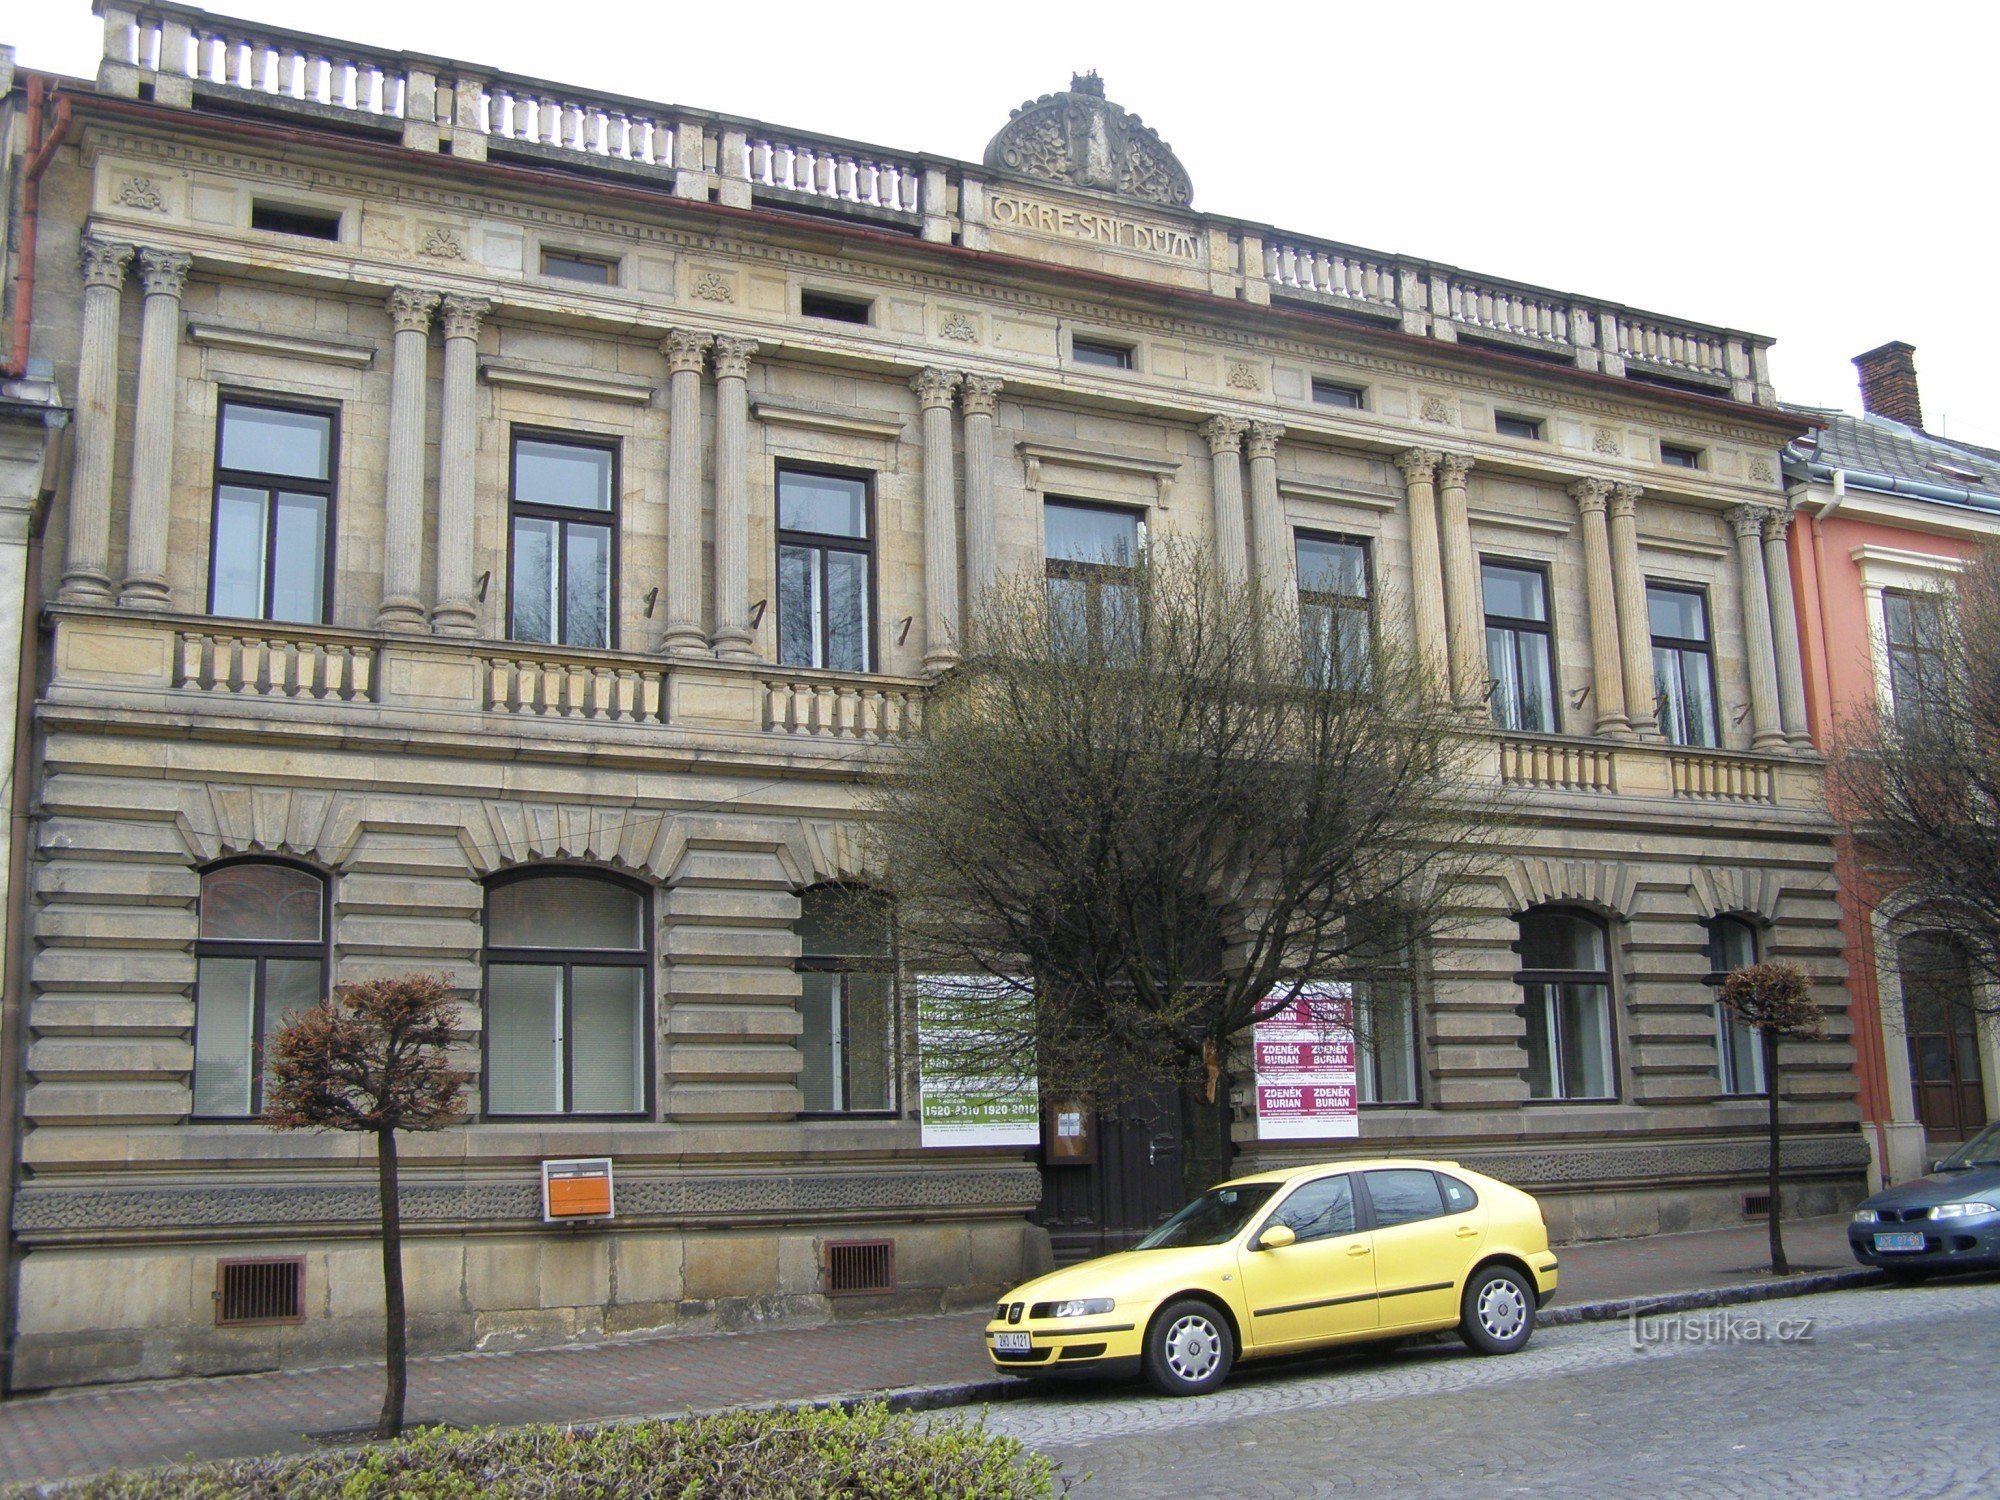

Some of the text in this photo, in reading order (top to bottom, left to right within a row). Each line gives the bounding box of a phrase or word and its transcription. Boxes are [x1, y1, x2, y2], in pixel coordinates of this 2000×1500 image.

[993, 196, 1197, 259] OKRESNÍ DŮM
[1264, 1012, 1297, 1021] URIAN
[1262, 1043, 1300, 1054] ZDENĚK
[1311, 1042, 1348, 1054] ZDENĚK
[1264, 1055, 1299, 1064] BURIAN
[1313, 1055, 1347, 1064] BURIAN
[1264, 1086, 1302, 1098] ZDENĚK
[1313, 1086, 1350, 1097] ZDENĚK
[1266, 1098, 1301, 1108] BURIAN
[1315, 1098, 1349, 1107] BURIAN
